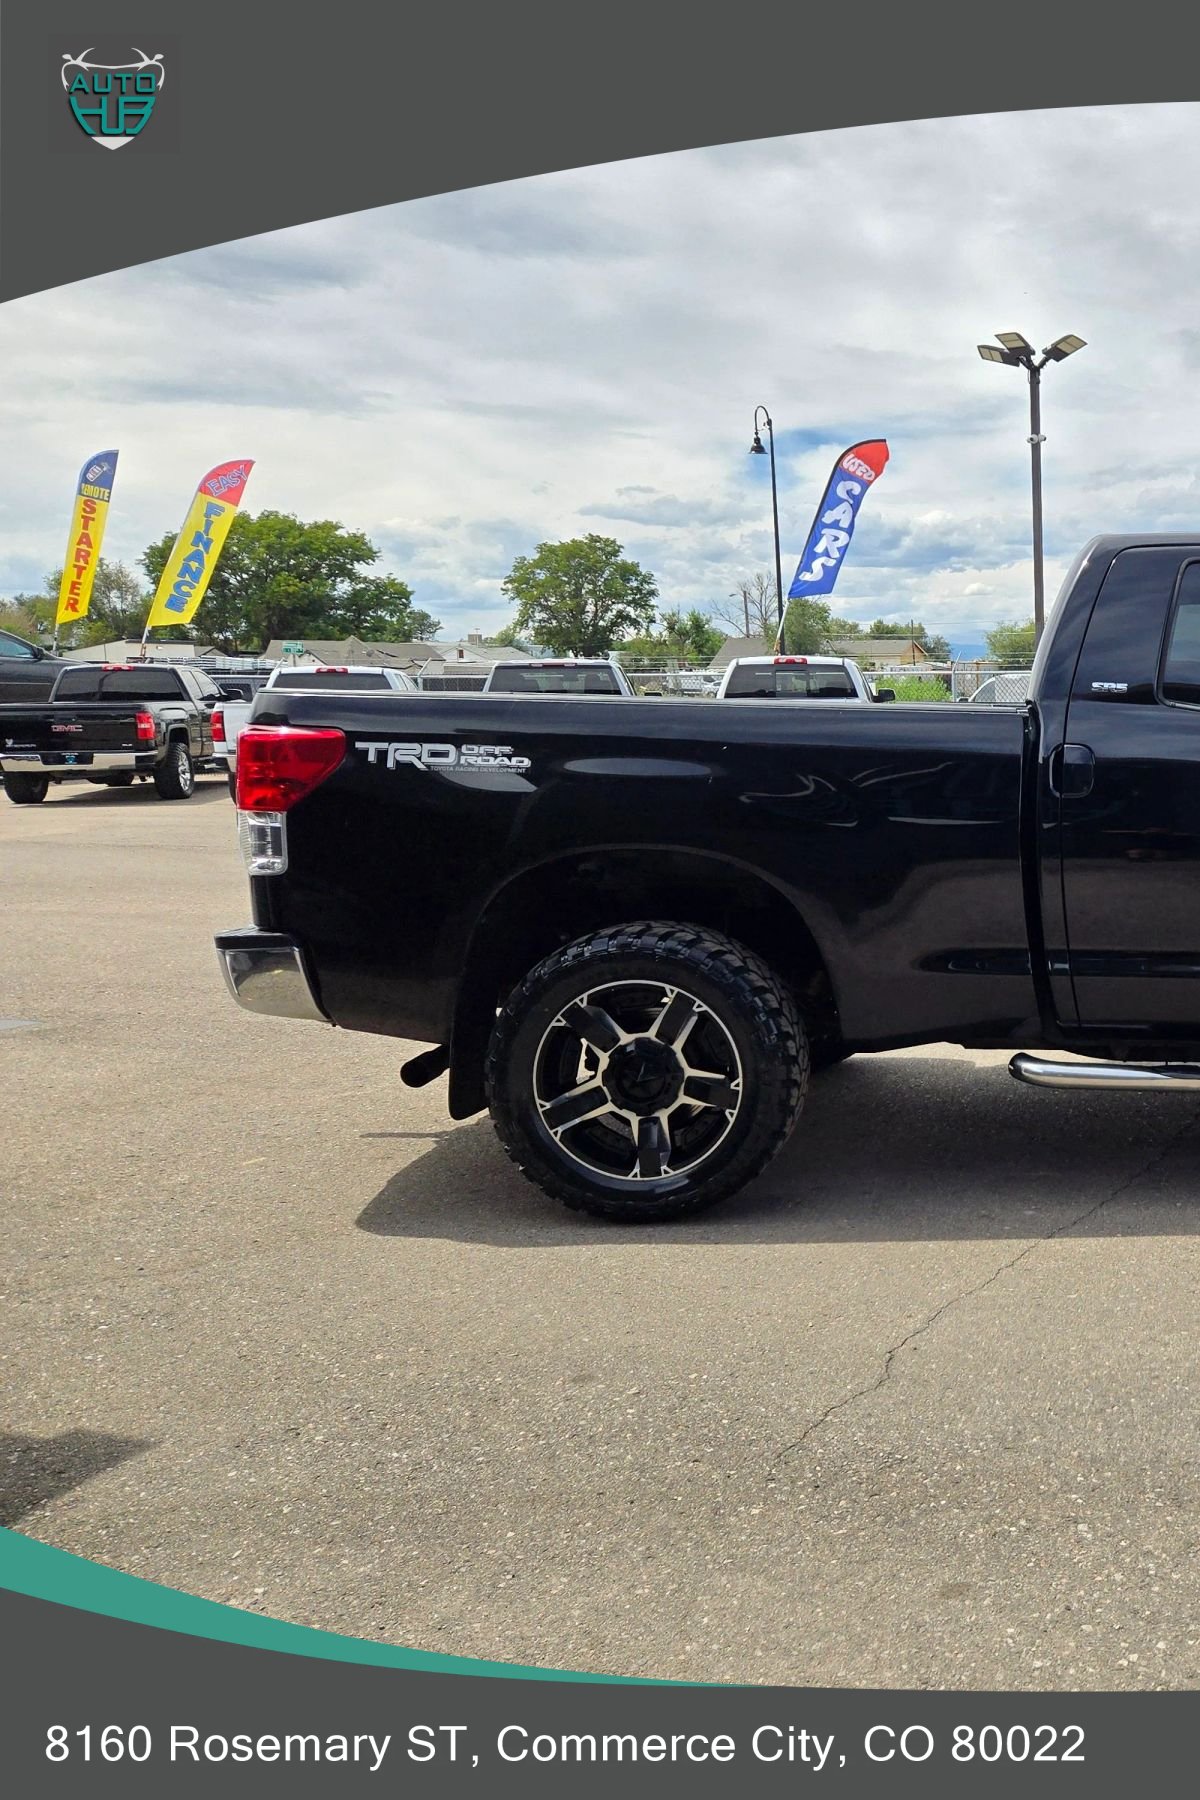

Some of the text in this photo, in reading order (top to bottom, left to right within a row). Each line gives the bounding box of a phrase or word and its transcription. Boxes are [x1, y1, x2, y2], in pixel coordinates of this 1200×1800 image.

[207, 465, 248, 497] EASY
[842, 453, 876, 481] USED
[798, 480, 862, 582] CARS
[64, 498, 97, 613] STARTER
[164, 501, 226, 613] FINANCE
[1091, 682, 1128, 693] SR5
[355, 741, 458, 771] TRD
[460, 756, 532, 768] ROAD
[461, 744, 514, 755] OFF
